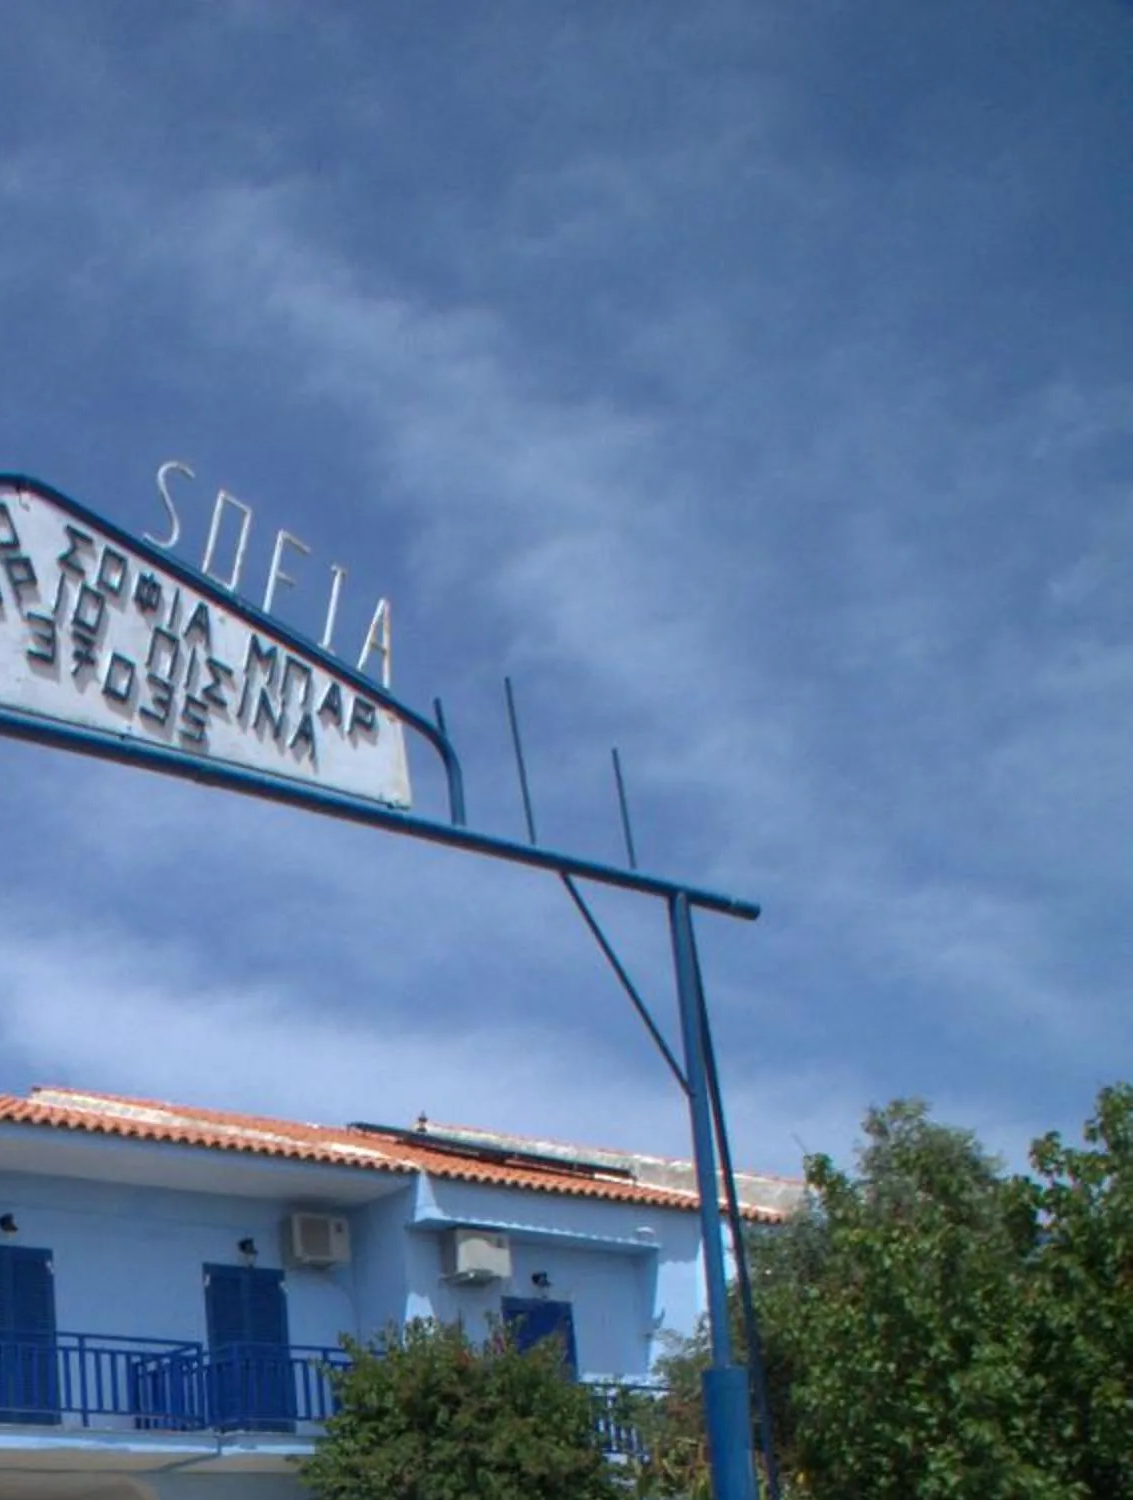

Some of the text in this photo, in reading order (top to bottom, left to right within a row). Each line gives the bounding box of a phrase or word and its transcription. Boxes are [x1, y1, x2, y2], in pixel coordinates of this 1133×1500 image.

[57, 524, 211, 650] ΣΟΦΙΑ
[241, 633, 377, 738] ΜΠΑΡ
[142, 460, 392, 689] SOFIA
[26, 611, 209, 743] 37035
[145, 625, 317, 764] ΠΙΣΙΝΑ
